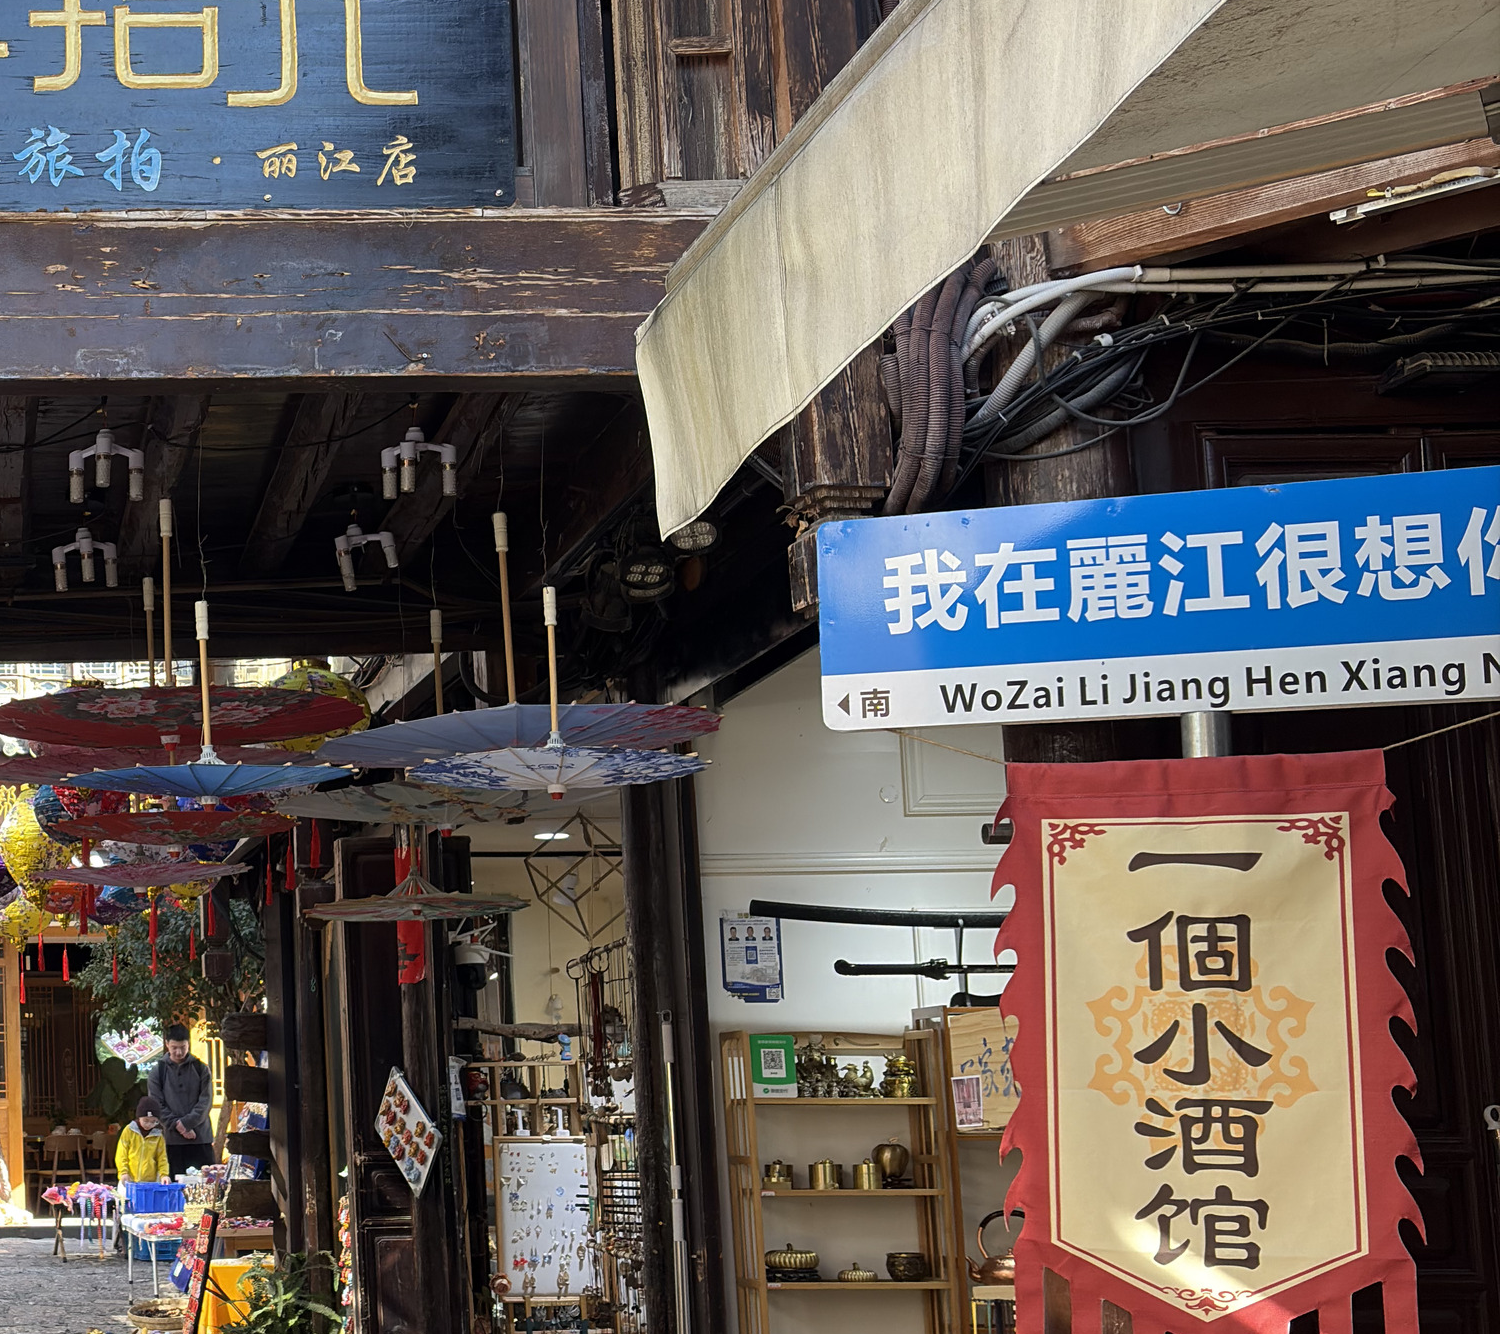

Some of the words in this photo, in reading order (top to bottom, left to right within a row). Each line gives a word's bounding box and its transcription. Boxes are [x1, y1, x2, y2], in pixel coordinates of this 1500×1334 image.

[255, 135, 418, 187] 丽江店
[859, 688, 891, 719] 南
[939, 676, 1065, 713] WoZai
[1079, 673, 1109, 706] Li
[1122, 671, 1230, 708] Jiang
[1245, 665, 1328, 697] Hen
[1340, 657, 1467, 696] Xiang
[1125, 850, 1274, 1270] 一個小酒馆
